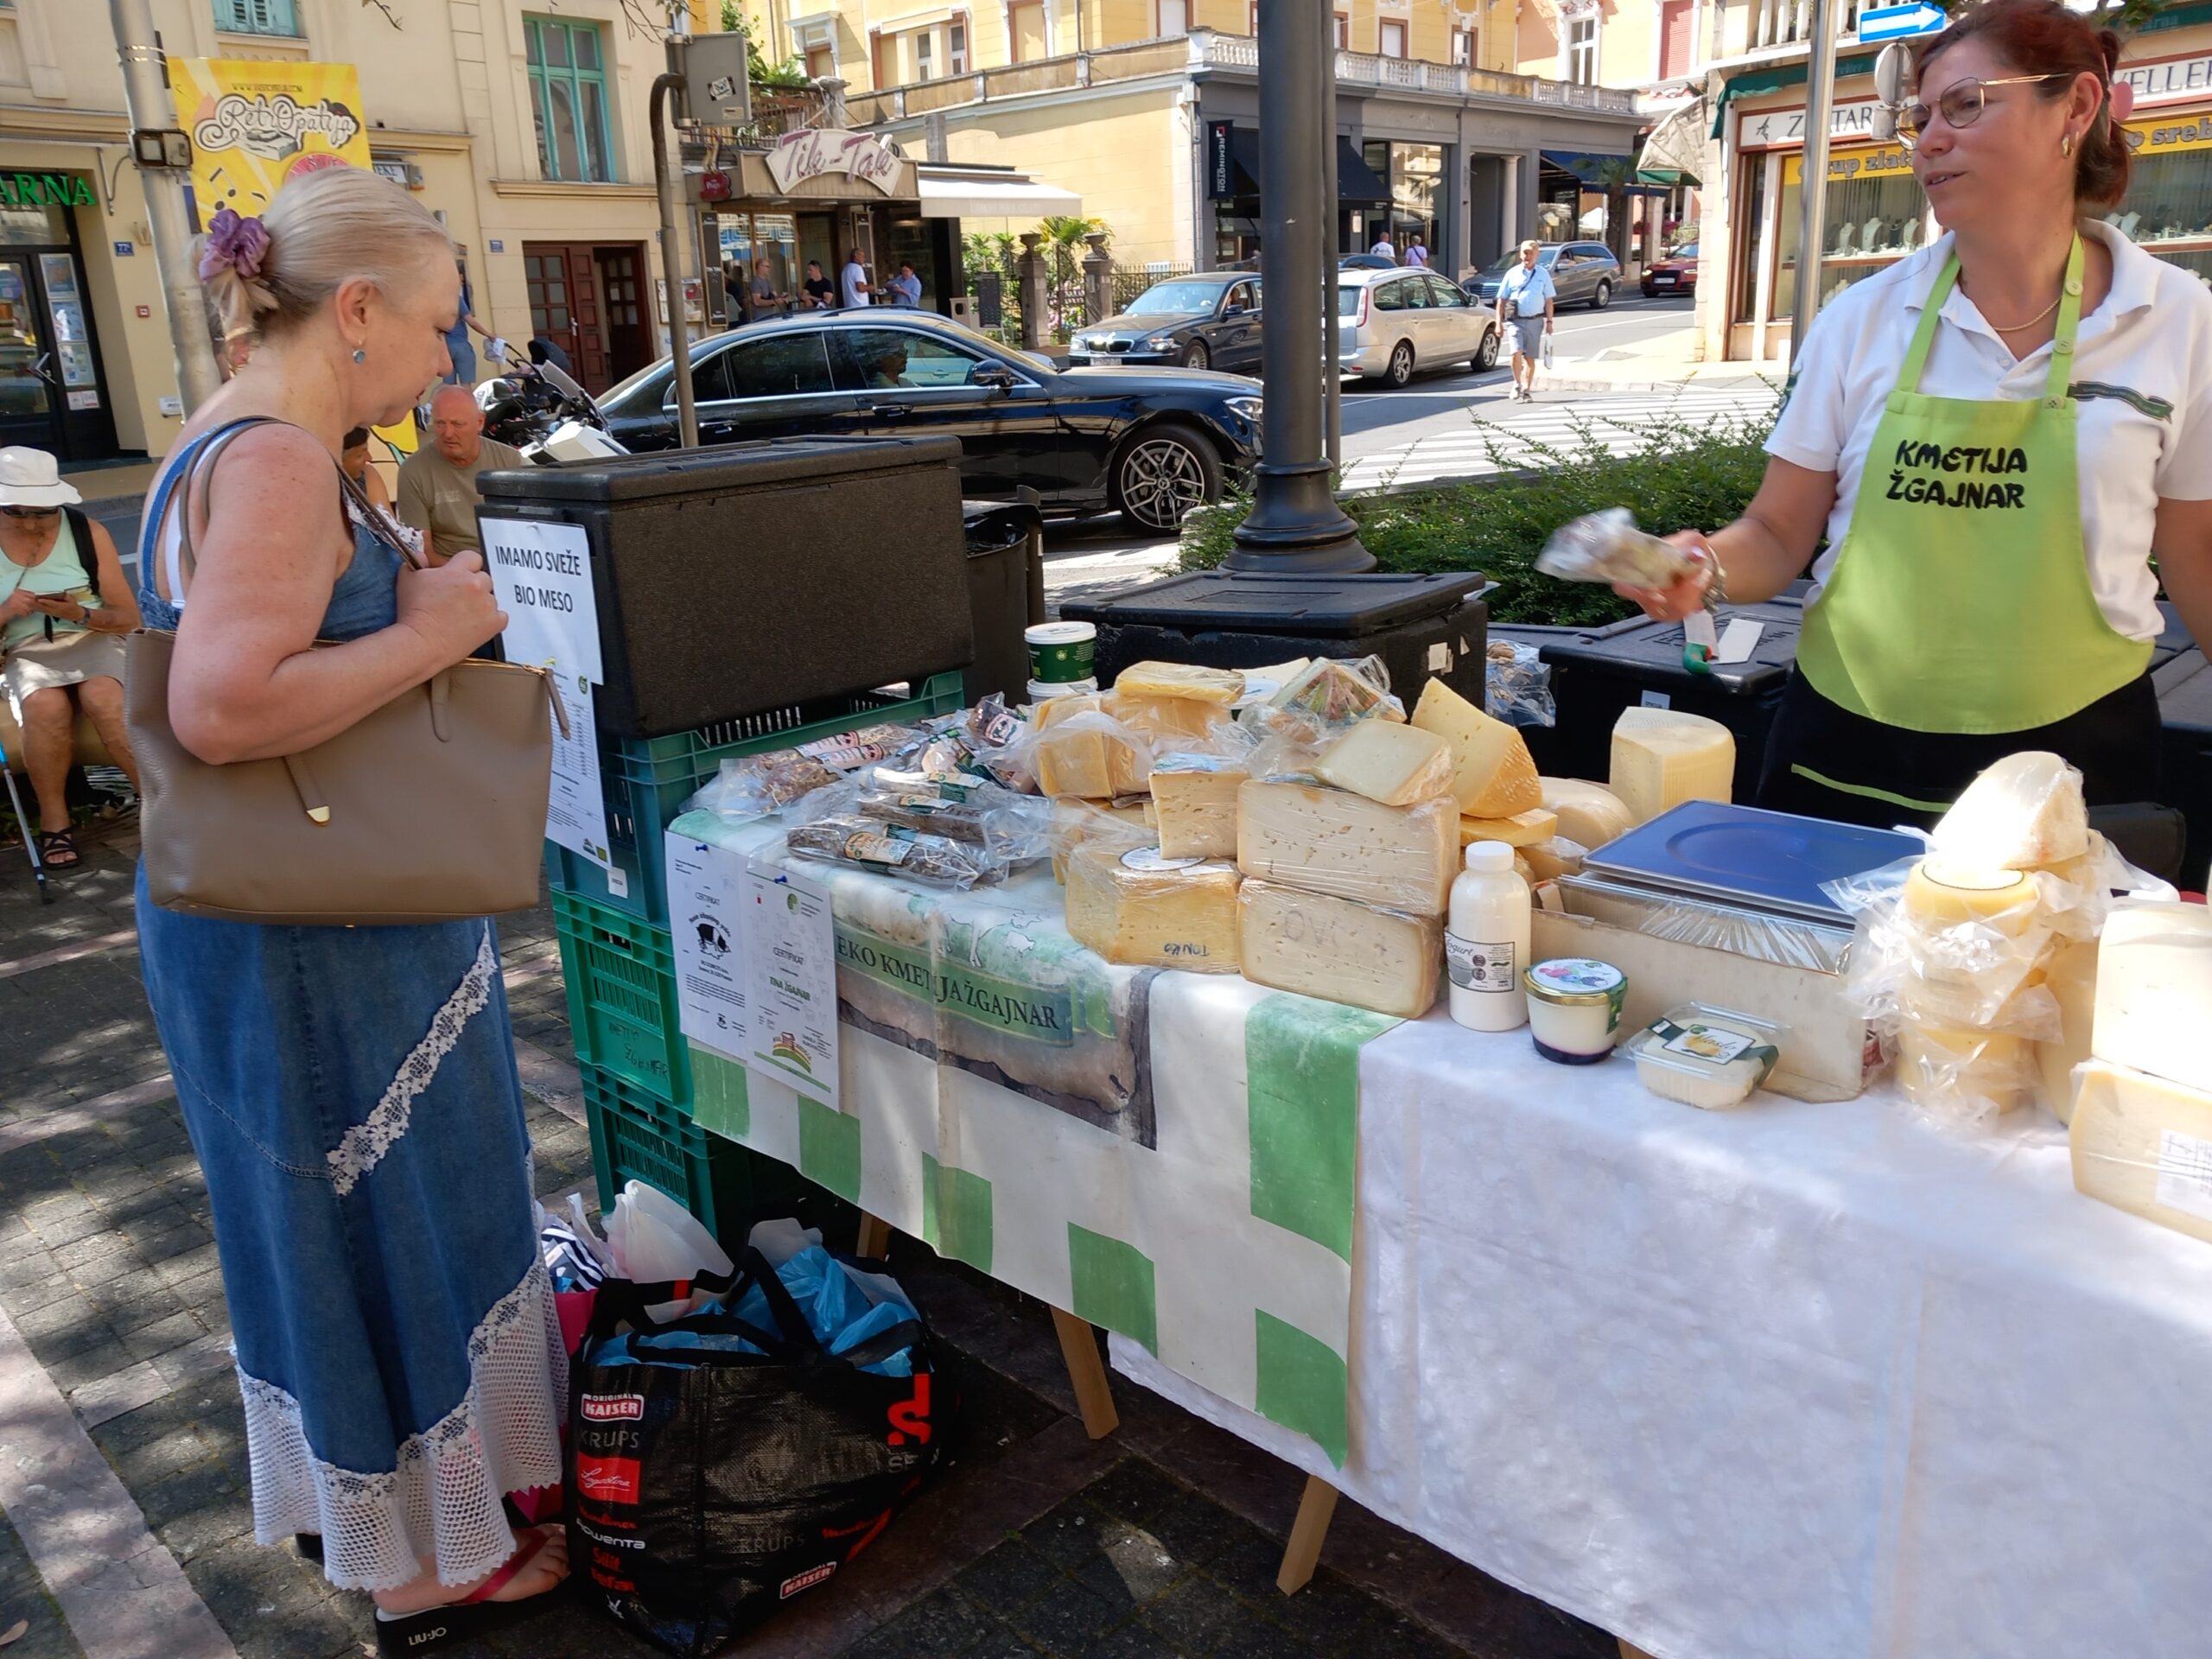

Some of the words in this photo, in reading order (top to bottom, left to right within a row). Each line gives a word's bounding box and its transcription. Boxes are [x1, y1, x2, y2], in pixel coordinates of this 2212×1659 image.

[779, 130, 893, 184] Tik-Tak
[1217, 137, 1226, 192] REMINGTON
[1895, 439, 2029, 474] KMETIJA
[1886, 468, 2025, 508] ŽGAJNAR
[495, 545, 543, 570] IMAMO
[545, 549, 582, 576] SVEŽE
[514, 584, 535, 607] BIO
[538, 588, 574, 613] MESO
[836, 935, 877, 968] EKO
[880, 953, 963, 1002] KMETIJA
[963, 981, 1061, 1030] ŽGAJNAR
[585, 1402, 639, 1416] KAISER
[590, 1393, 633, 1402] ORIGINAL
[581, 1429, 640, 1449] KRUPS
[785, 1567, 833, 1594] KAISER
